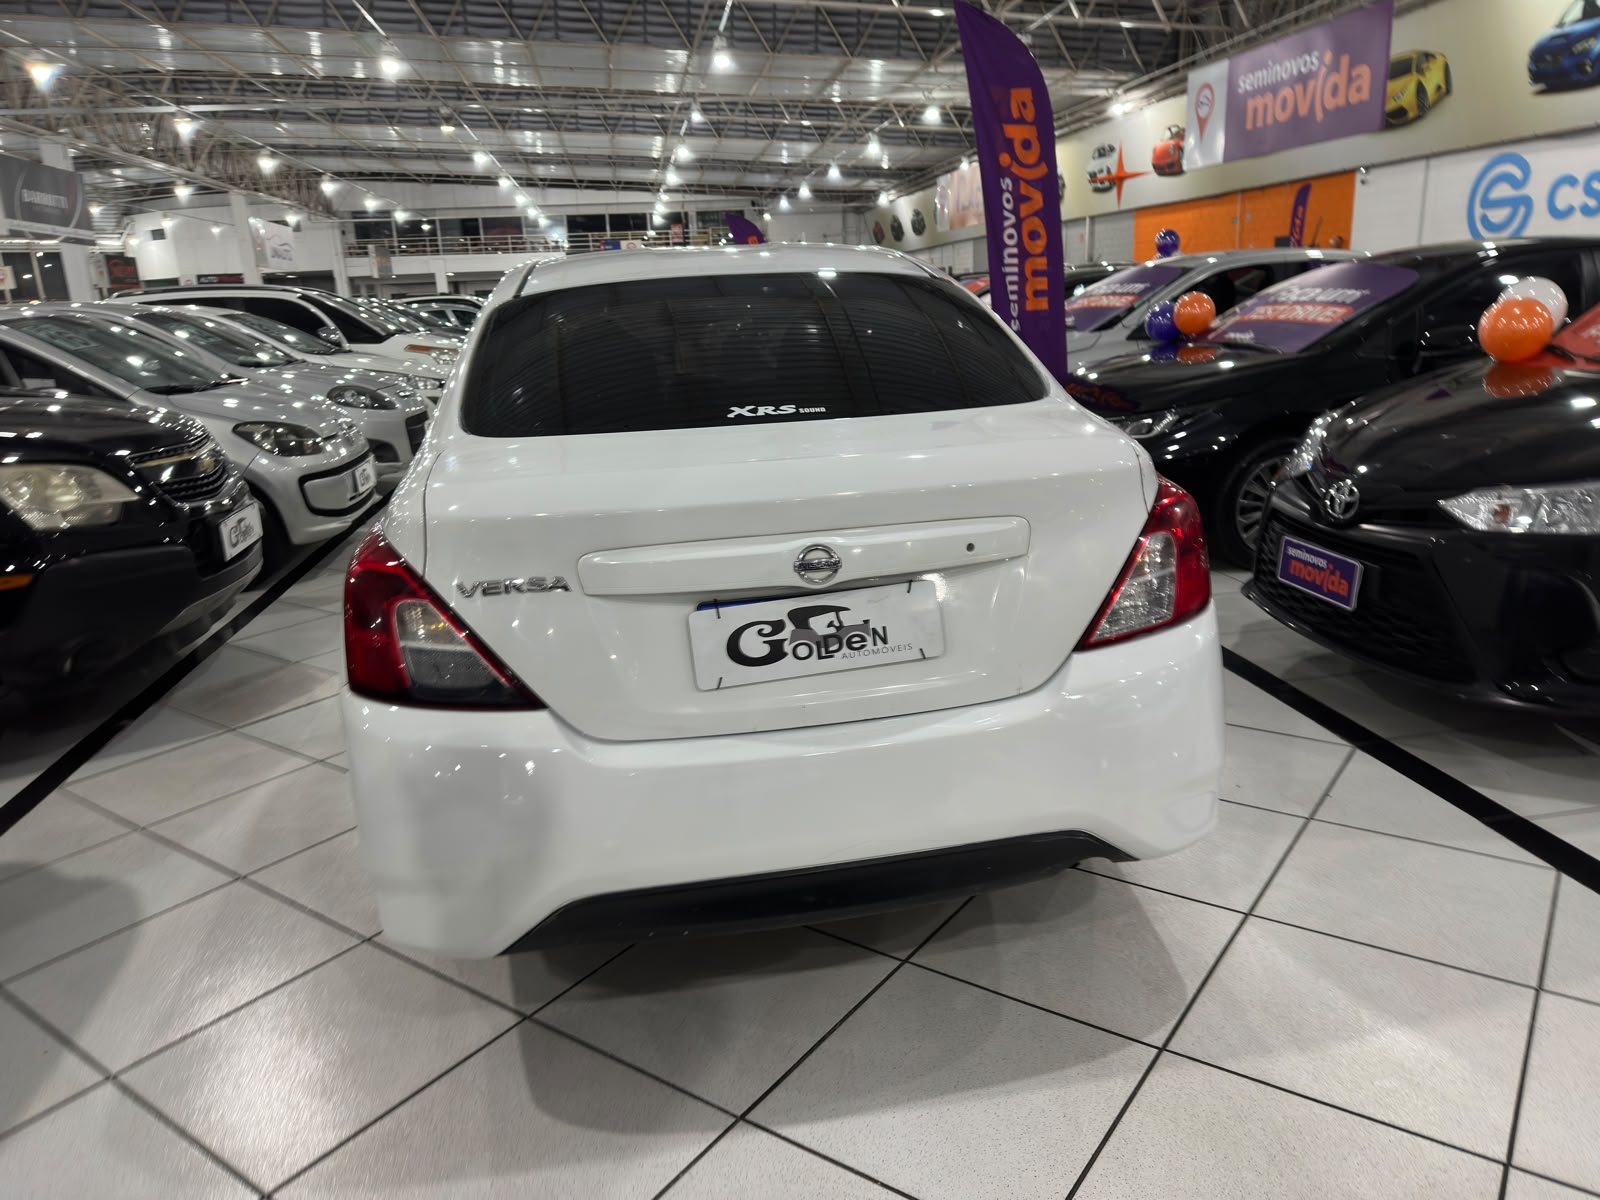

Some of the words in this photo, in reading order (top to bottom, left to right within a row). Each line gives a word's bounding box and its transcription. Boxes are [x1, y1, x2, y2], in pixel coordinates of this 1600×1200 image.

[1238, 50, 1320, 94] seminovos
[1246, 49, 1371, 130] movida
[999, 87, 1048, 311] movida
[1000, 177, 1020, 331] seminovos
[727, 405, 797, 418] XRS
[1286, 546, 1328, 569] seminovos
[456, 576, 571, 598] VERSA
[1290, 559, 1349, 598] movida
